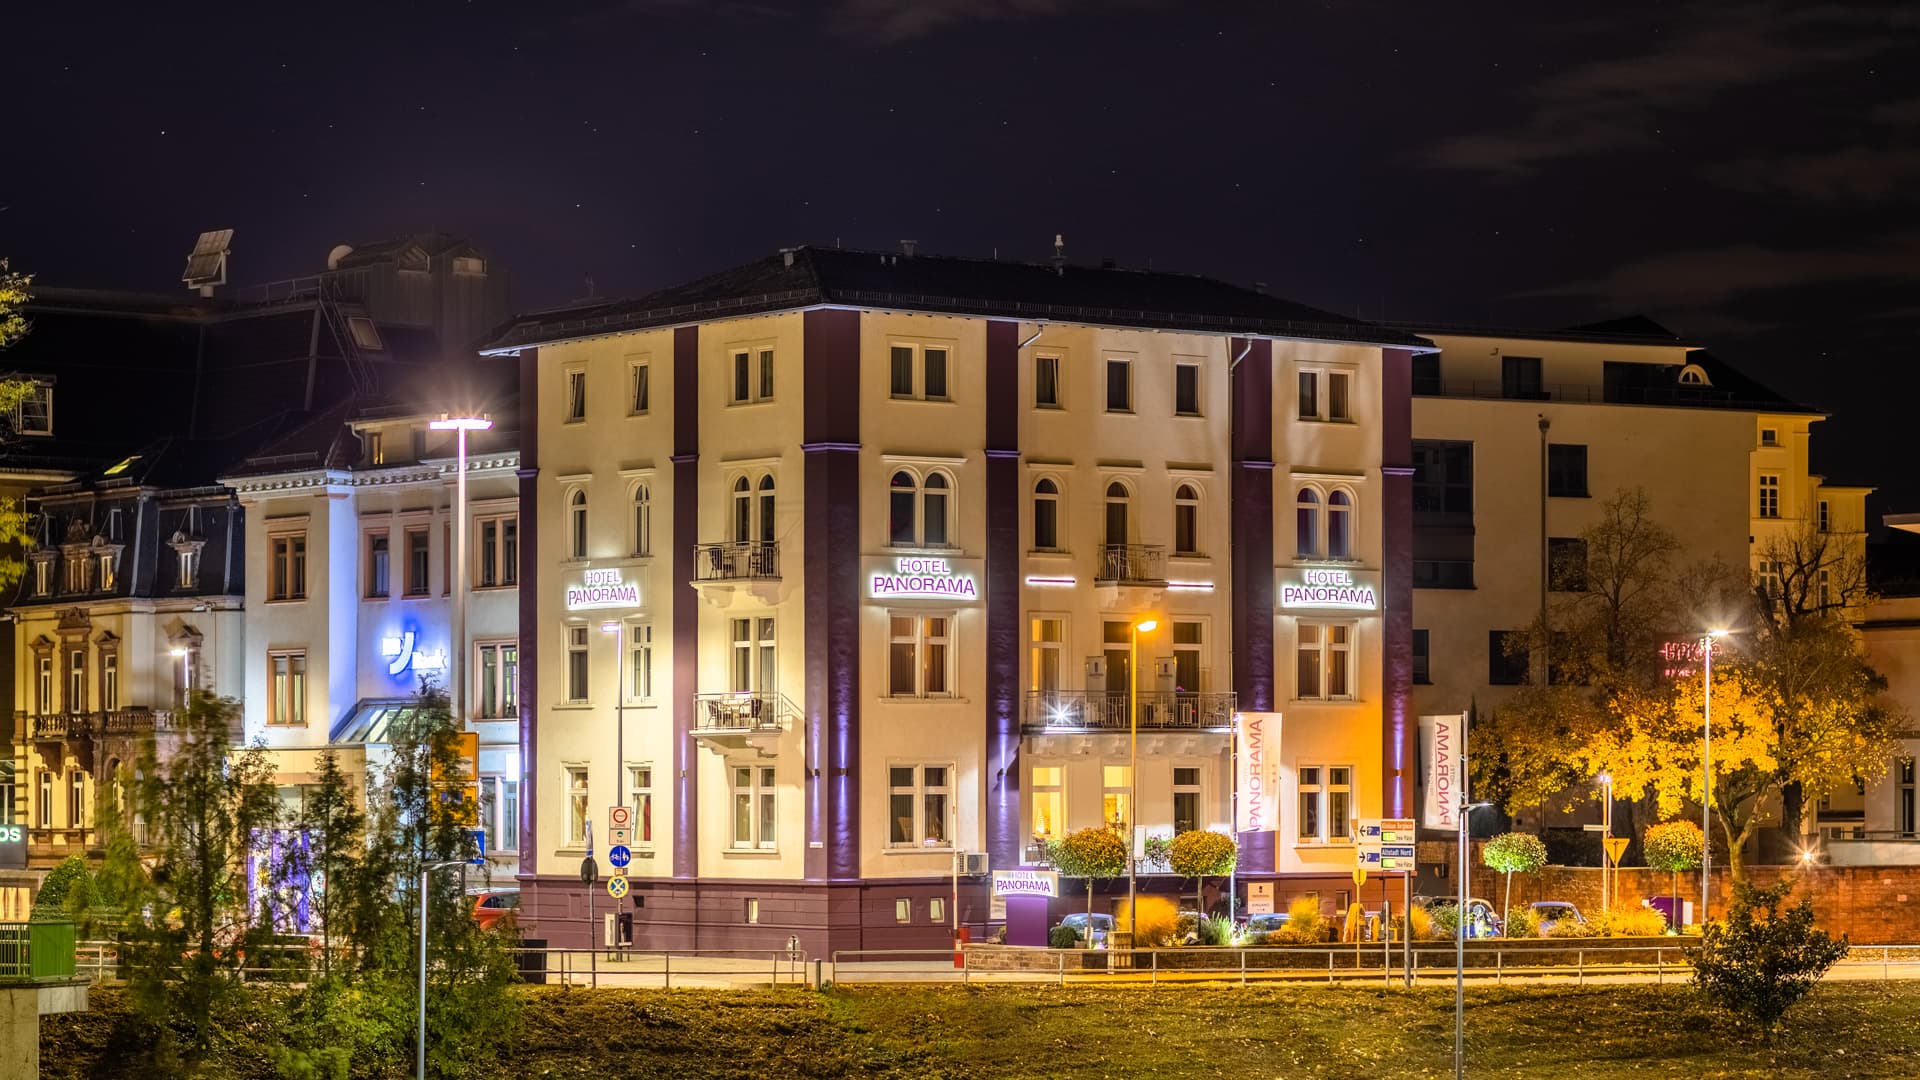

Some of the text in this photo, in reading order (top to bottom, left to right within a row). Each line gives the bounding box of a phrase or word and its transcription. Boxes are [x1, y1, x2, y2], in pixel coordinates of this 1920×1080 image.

[900, 559, 951, 573] HOTEL
[585, 570, 620, 584] HOTEL
[1307, 571, 1353, 584] HOTEL
[874, 576, 976, 596] PANORAMA
[568, 586, 638, 606] PANORAMA
[1284, 587, 1375, 606] PANORAMA
[1249, 719, 1263, 829] PANORAMA
[1011, 871, 1035, 880] HOTEL
[996, 880, 1051, 893] PANORAMA
